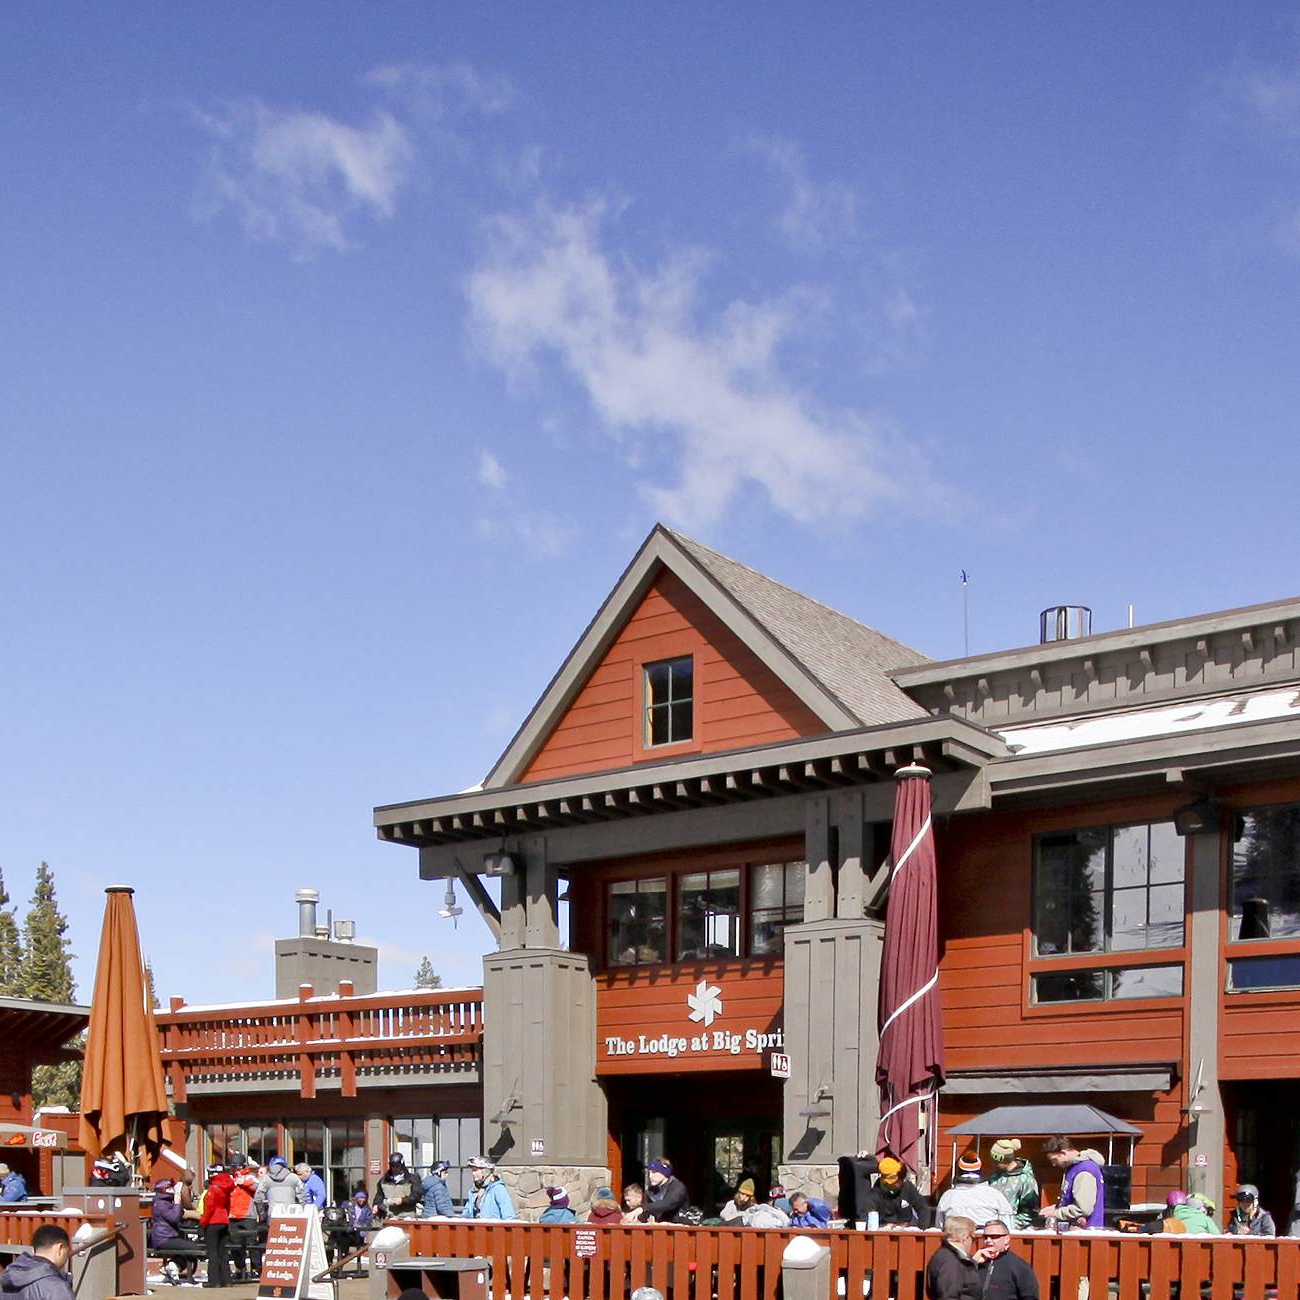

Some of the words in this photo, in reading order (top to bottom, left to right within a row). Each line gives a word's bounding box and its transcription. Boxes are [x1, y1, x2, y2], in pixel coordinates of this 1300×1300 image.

[605, 1036, 635, 1055] The
[638, 1034, 687, 1058] Lodge
[691, 1032, 709, 1051] at
[712, 1030, 742, 1053] Big
[745, 1028, 784, 1053] Spri
